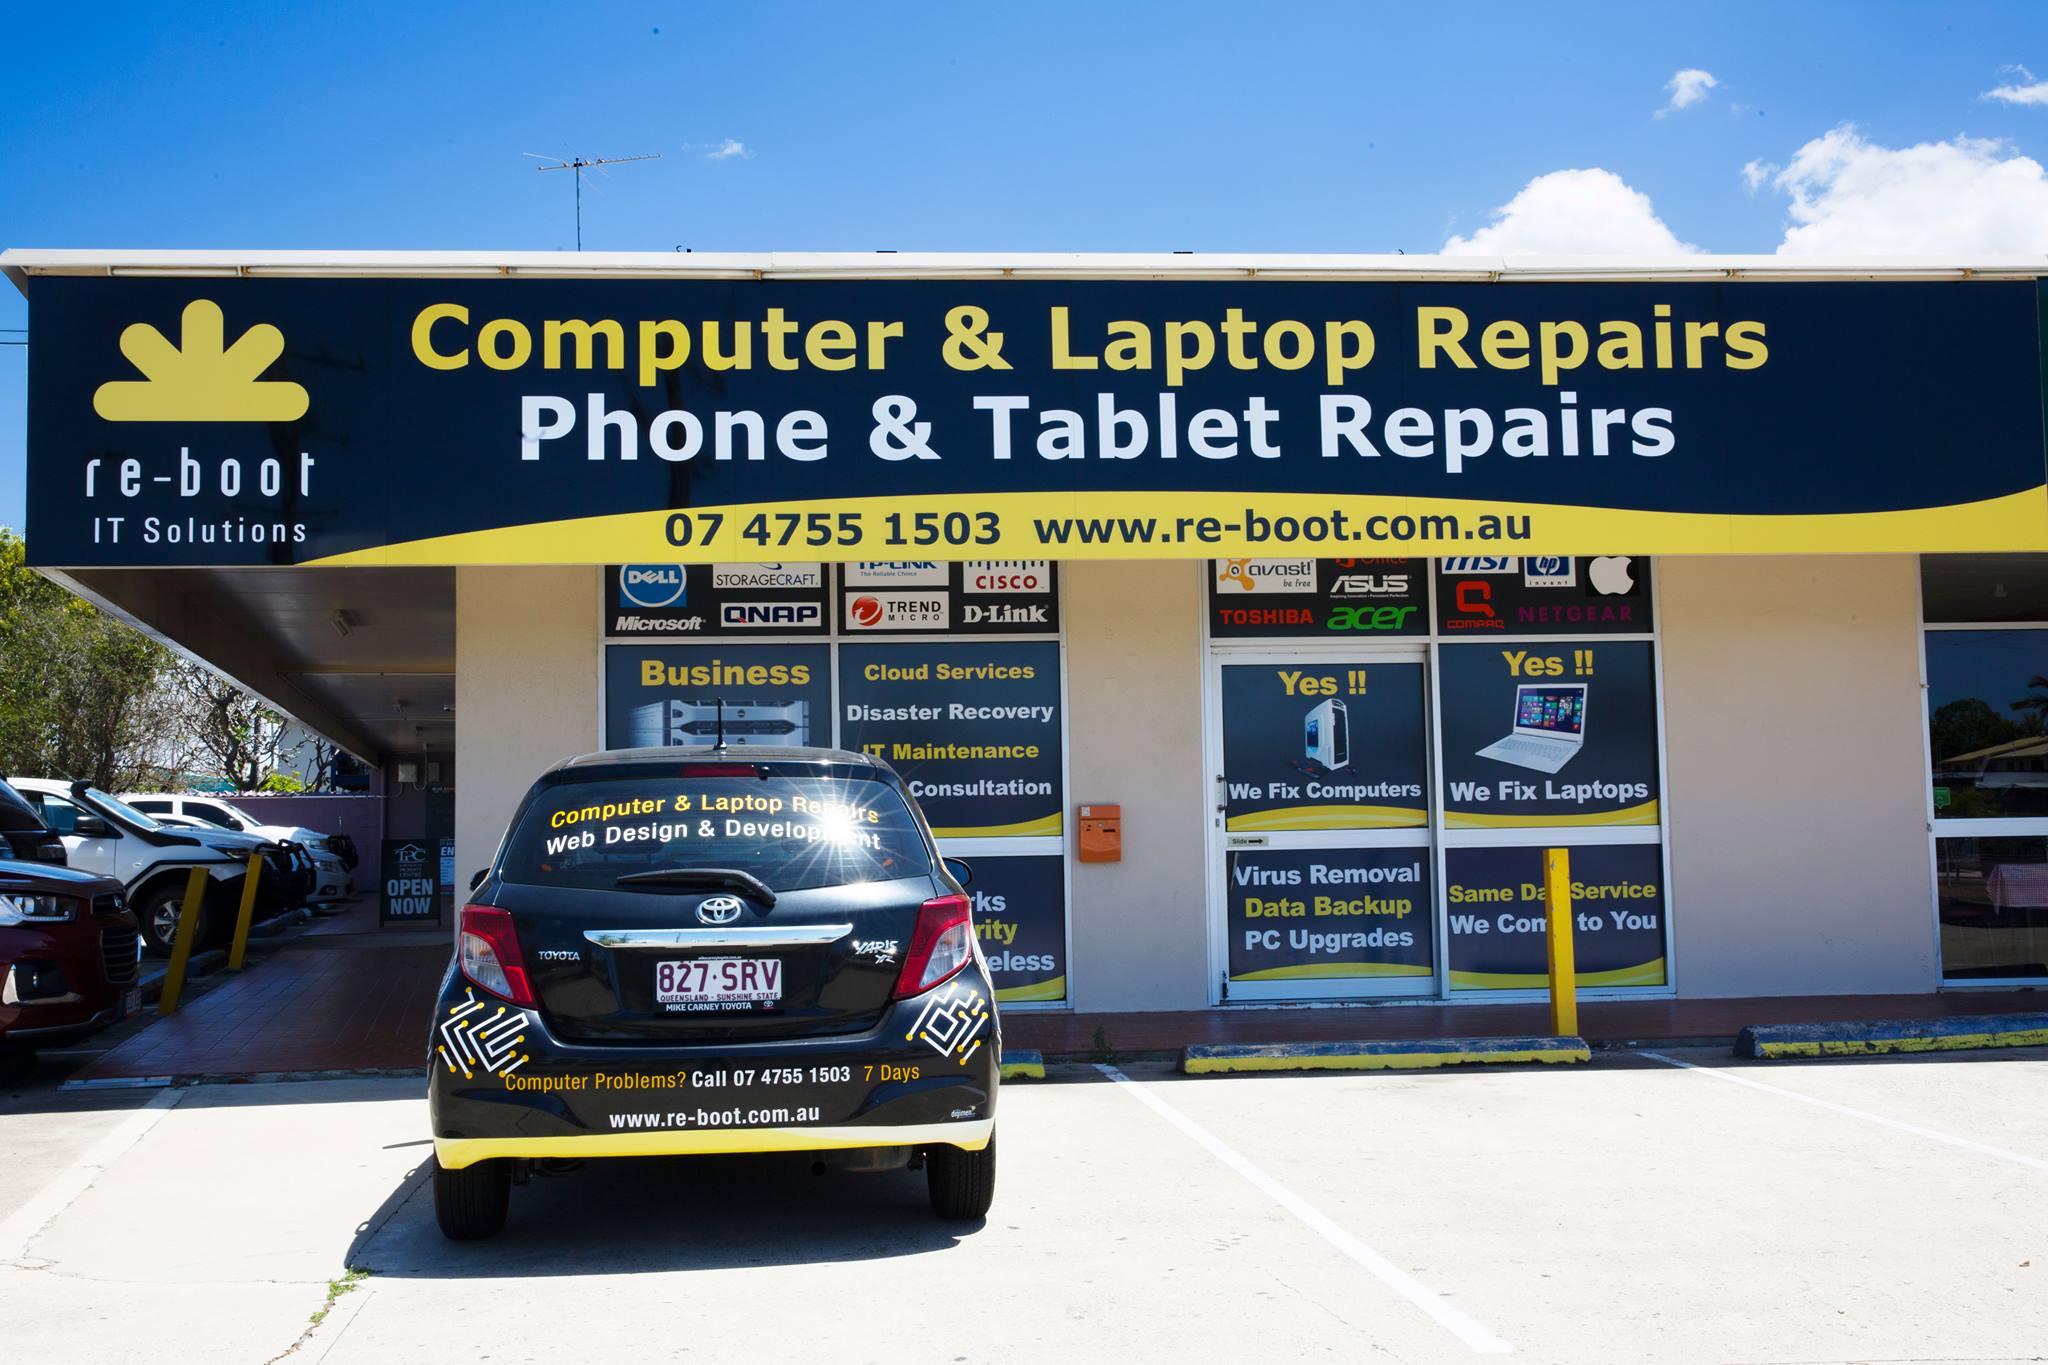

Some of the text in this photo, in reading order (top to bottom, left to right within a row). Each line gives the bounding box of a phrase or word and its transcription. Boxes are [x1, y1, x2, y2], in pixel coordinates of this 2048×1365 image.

[411, 303, 1769, 386] Computer & Laptop Repairs
[520, 391, 1676, 473] Phone & Tablet Repairs
[86, 447, 314, 496] re-boot
[94, 517, 306, 543] IT Solutions
[664, 509, 1531, 546] 07 4755 1503 www.re-boot.com.au
[628, 570, 679, 584] DELL
[975, 575, 1038, 590] CISCO
[1283, 578, 1311, 588] be free
[1330, 574, 1409, 593] ASUS
[724, 606, 818, 624] QNAP
[887, 601, 941, 613] TREND
[963, 605, 1048, 624] D-Link
[1519, 606, 1632, 622] NETGEAR
[615, 616, 703, 631] Microsoft
[1219, 609, 1313, 625] TOSHIBA
[1327, 606, 1418, 630] acer
[1447, 619, 1505, 629] COMPAQ
[864, 663, 1035, 681] Cloud Services
[1502, 650, 1594, 676] Yes !!
[641, 660, 810, 687] Business
[1277, 670, 1366, 696] Yes !!
[847, 703, 1053, 722] Disaster Recovery
[863, 743, 1039, 760] IT Maintenance
[908, 779, 1052, 797] Consultation
[1228, 781, 1421, 802] We Fix Computers
[1450, 779, 1648, 804] We Fix Laptops
[551, 797, 666, 829] Computer
[675, 795, 691, 812] &
[702, 795, 782, 815] Laptop
[546, 818, 881, 856] Web Design & Developnt
[1232, 837, 1248, 845] Slide
[1235, 862, 1420, 886] Virus Removal
[387, 879, 433, 896] OPEN
[1449, 880, 1657, 903] Same Da Service
[390, 897, 431, 915] NOW
[1245, 895, 1412, 919] Data Backup
[1450, 911, 1657, 935] We Com to You
[1245, 927, 1414, 953] PC Upgrades
[538, 950, 580, 961] TOYOTA
[661, 994, 709, 1002] QUEENSLAND
[716, 993, 752, 1001] SUNSHINE
[756, 991, 778, 1000] STATE
[666, 1002, 752, 1011] MIKE CARNEY TOYOTA
[505, 1064, 920, 1093] Computer Problems? Call 07 4755 1503 7 Days
[609, 1106, 820, 1128] www.re-boot.com.au
